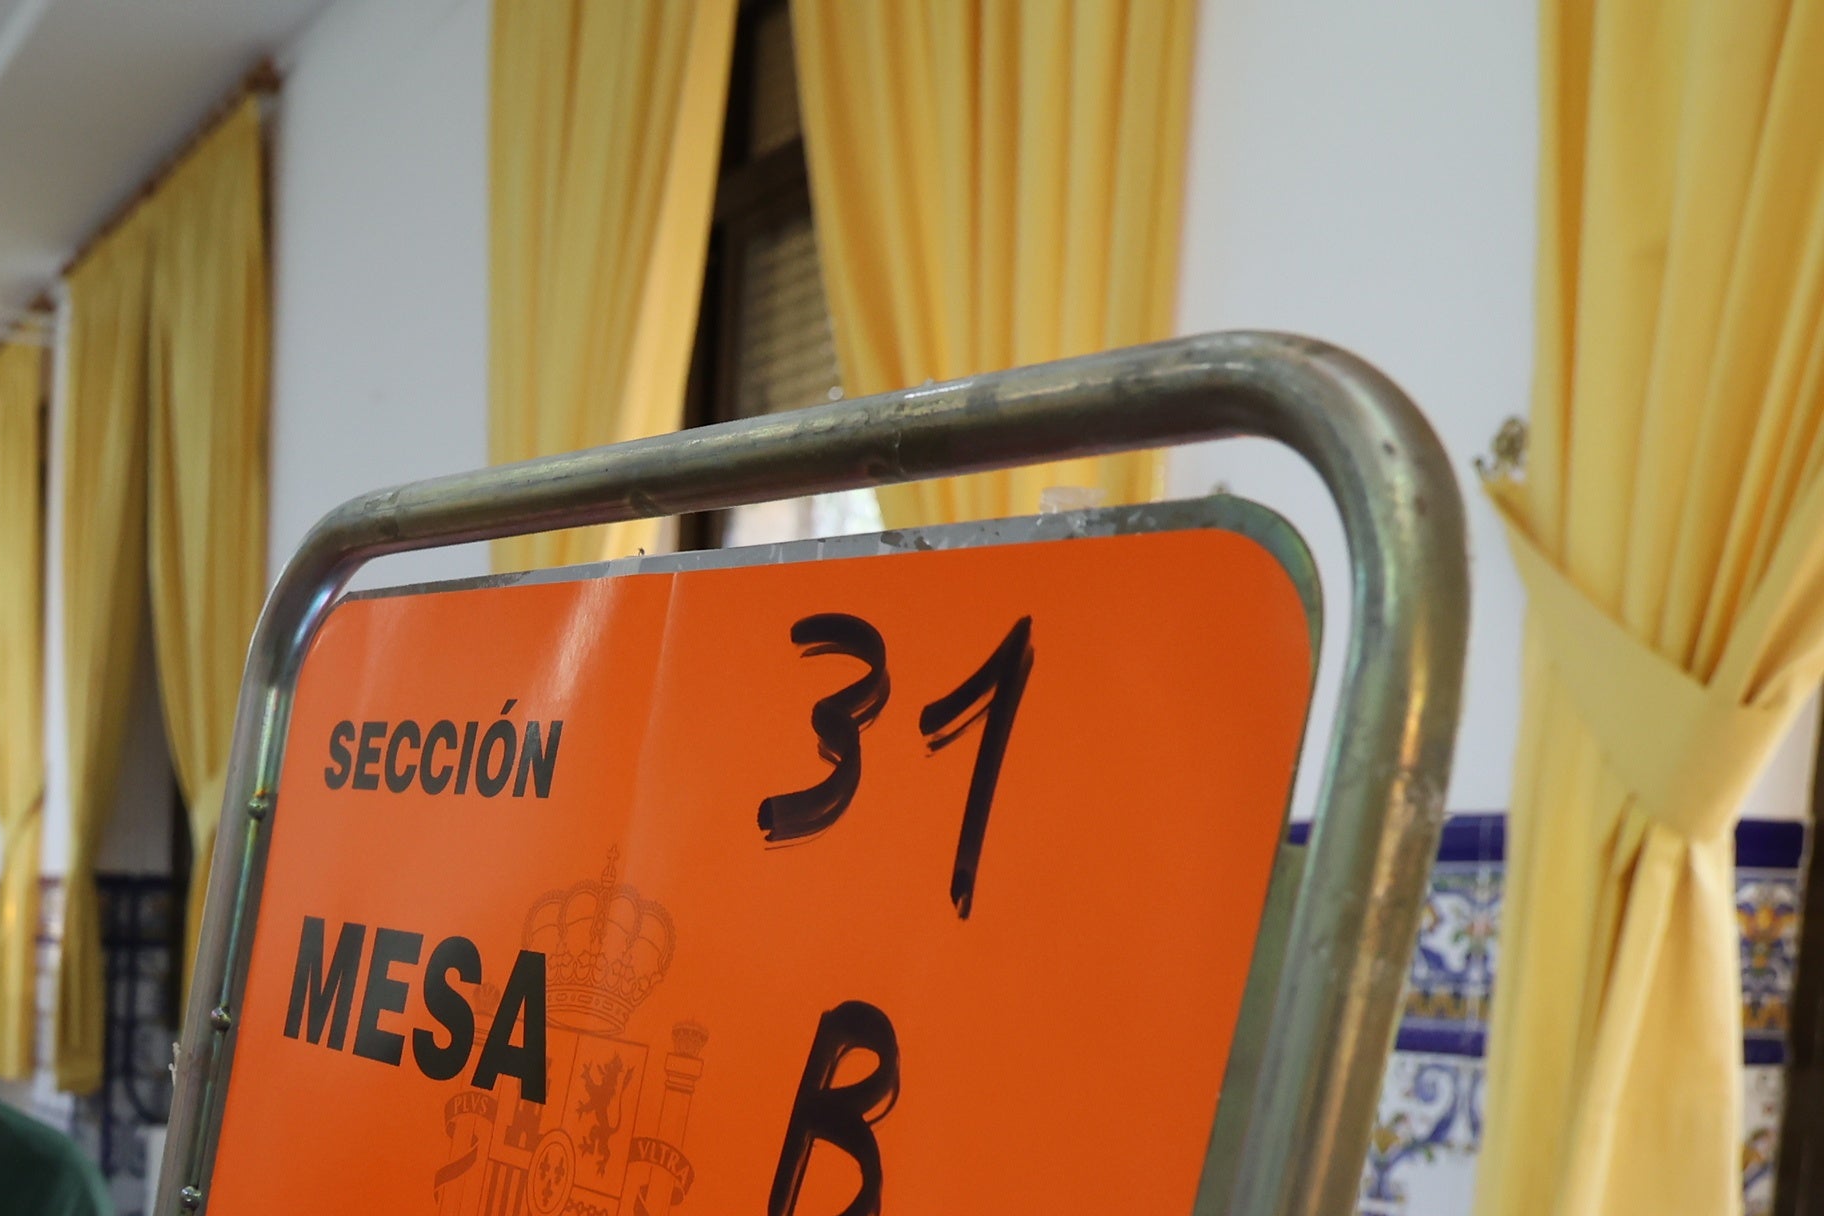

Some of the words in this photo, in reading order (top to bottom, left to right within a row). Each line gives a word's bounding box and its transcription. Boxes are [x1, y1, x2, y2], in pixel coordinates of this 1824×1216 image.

[324, 698, 564, 800] SECCIÓN
[755, 611, 1036, 922] 31
[282, 916, 549, 1106] MESA
[637, 1140, 693, 1184] VLTRA
